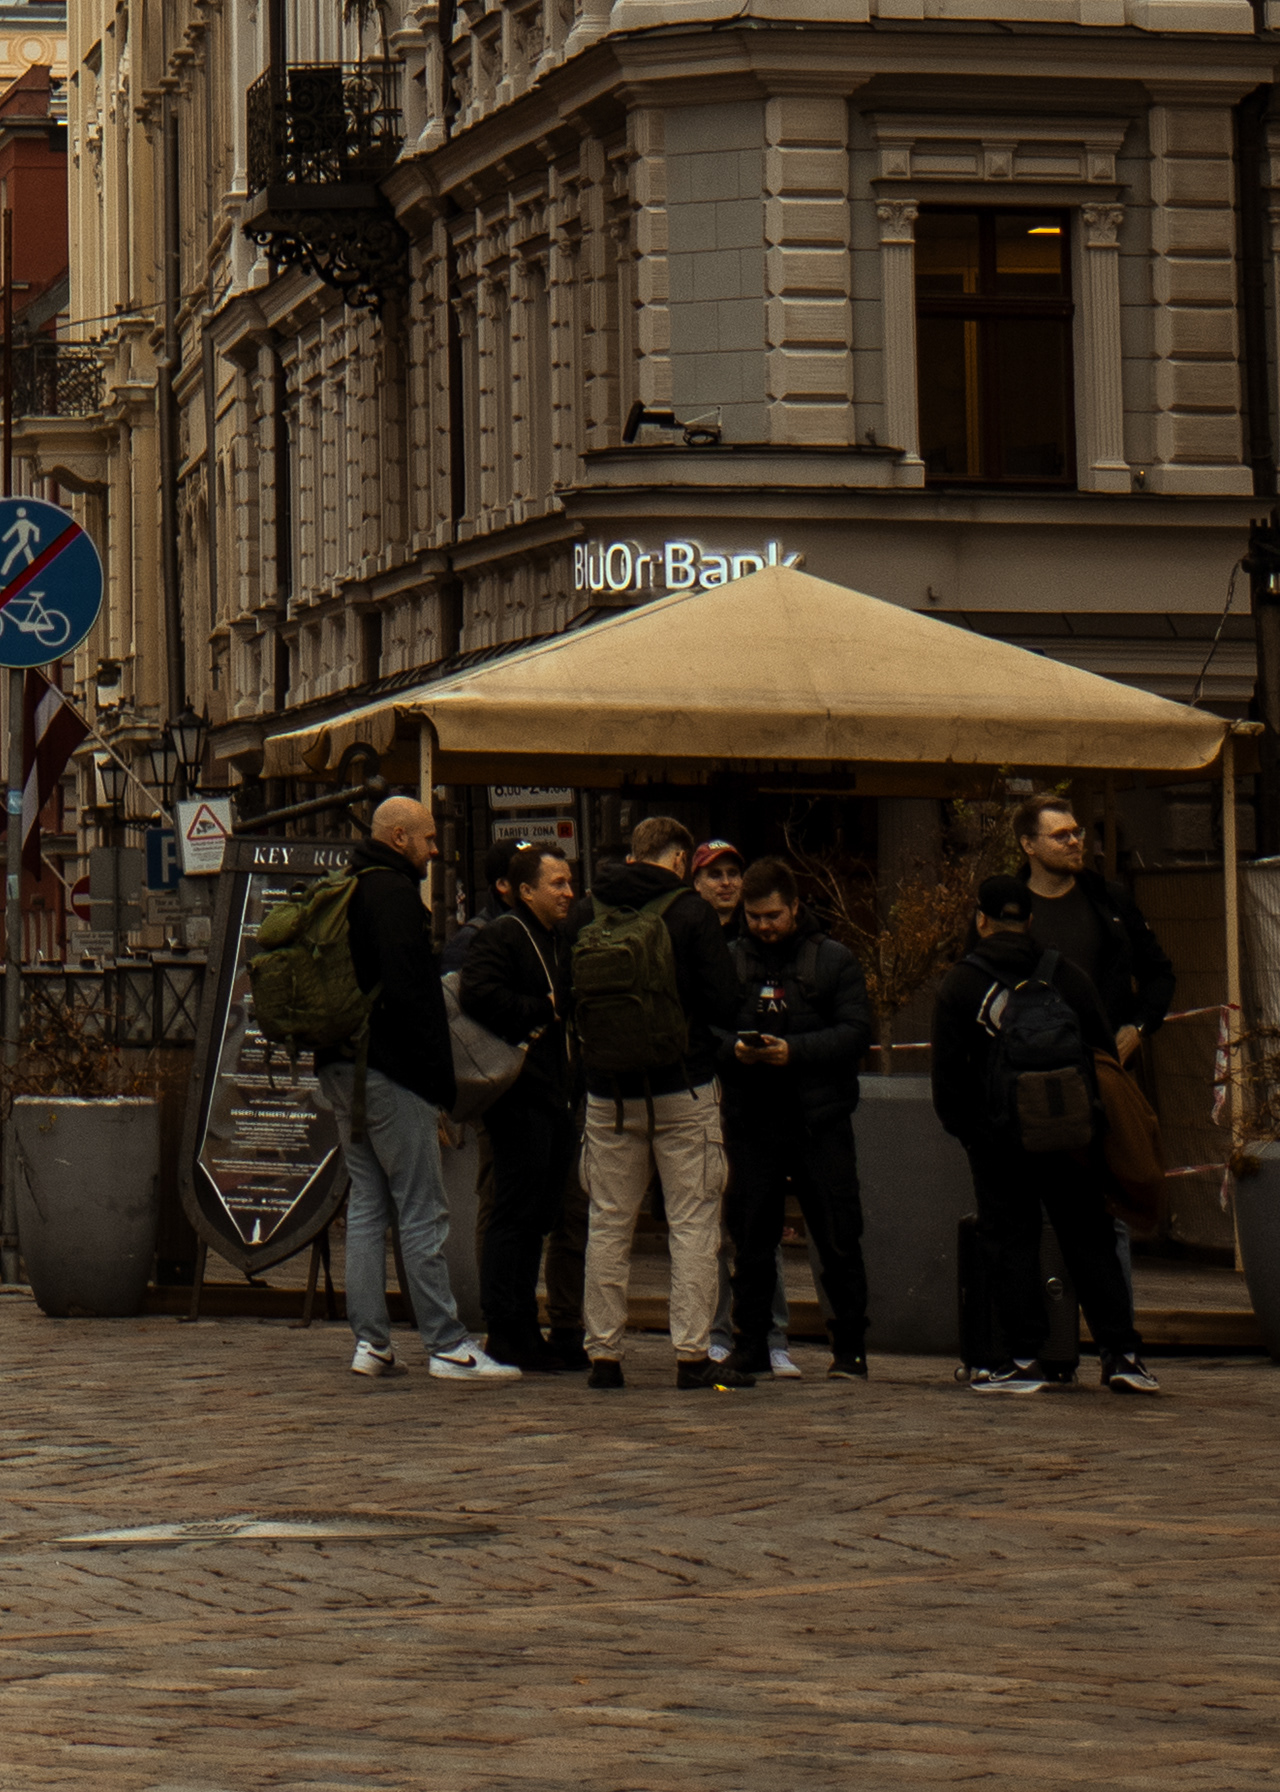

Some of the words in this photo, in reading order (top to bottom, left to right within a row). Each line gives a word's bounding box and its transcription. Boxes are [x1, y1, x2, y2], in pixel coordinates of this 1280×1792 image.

[573, 541, 652, 591] BluOr
[498, 827, 529, 837] TARIFU
[533, 826, 554, 836] ZONA
[253, 846, 294, 865] KEY
[313, 849, 350, 867] RIG
[756, 999, 789, 1013] EAN
